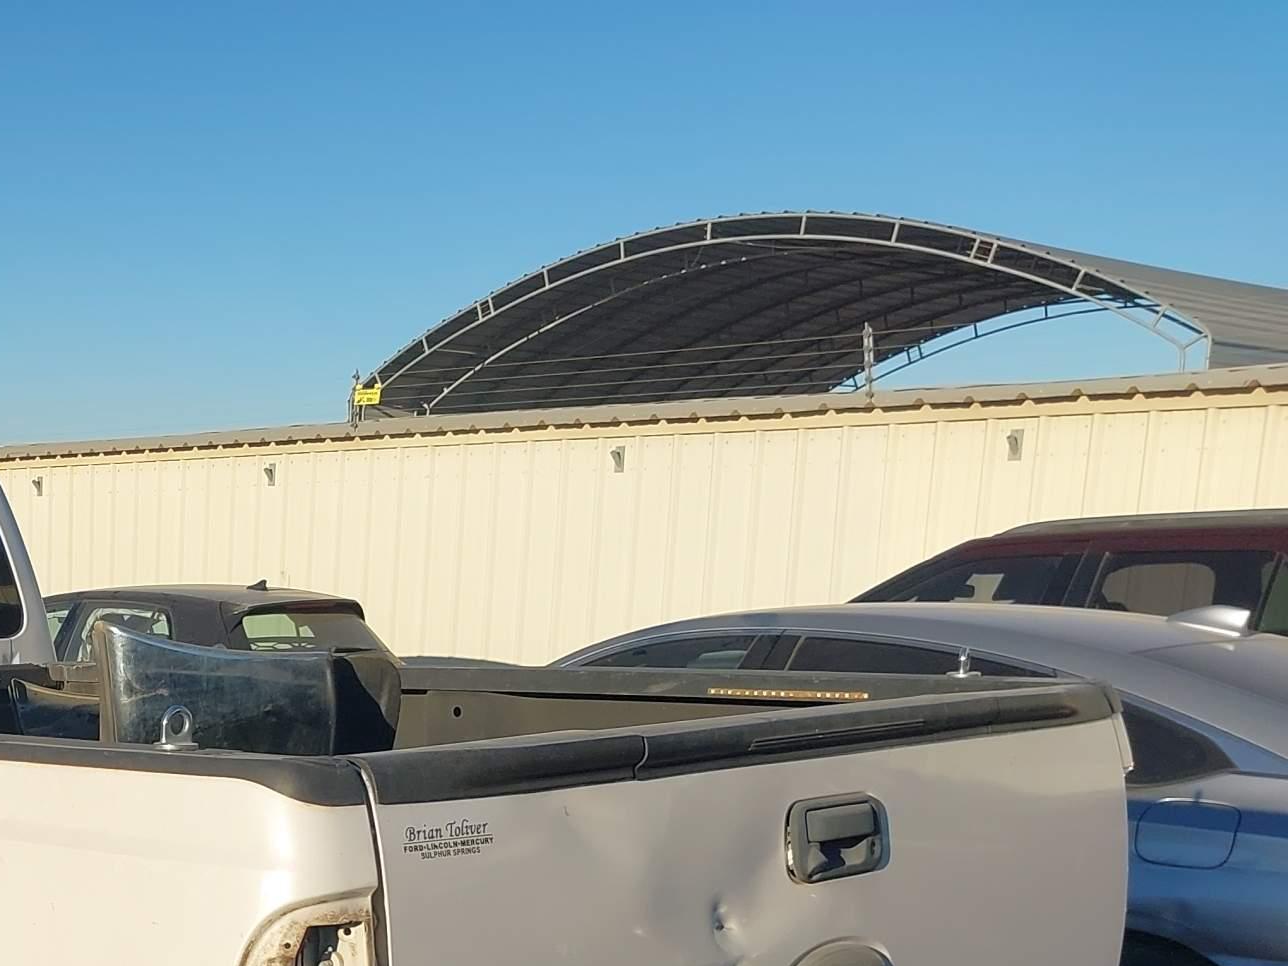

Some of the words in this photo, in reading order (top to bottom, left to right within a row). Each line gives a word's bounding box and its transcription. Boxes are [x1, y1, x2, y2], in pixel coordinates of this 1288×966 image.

[405, 824, 443, 842] Brian
[446, 818, 488, 837] Toliver
[421, 850, 452, 860] SULPHUR
[453, 846, 481, 856] SPRINGS
